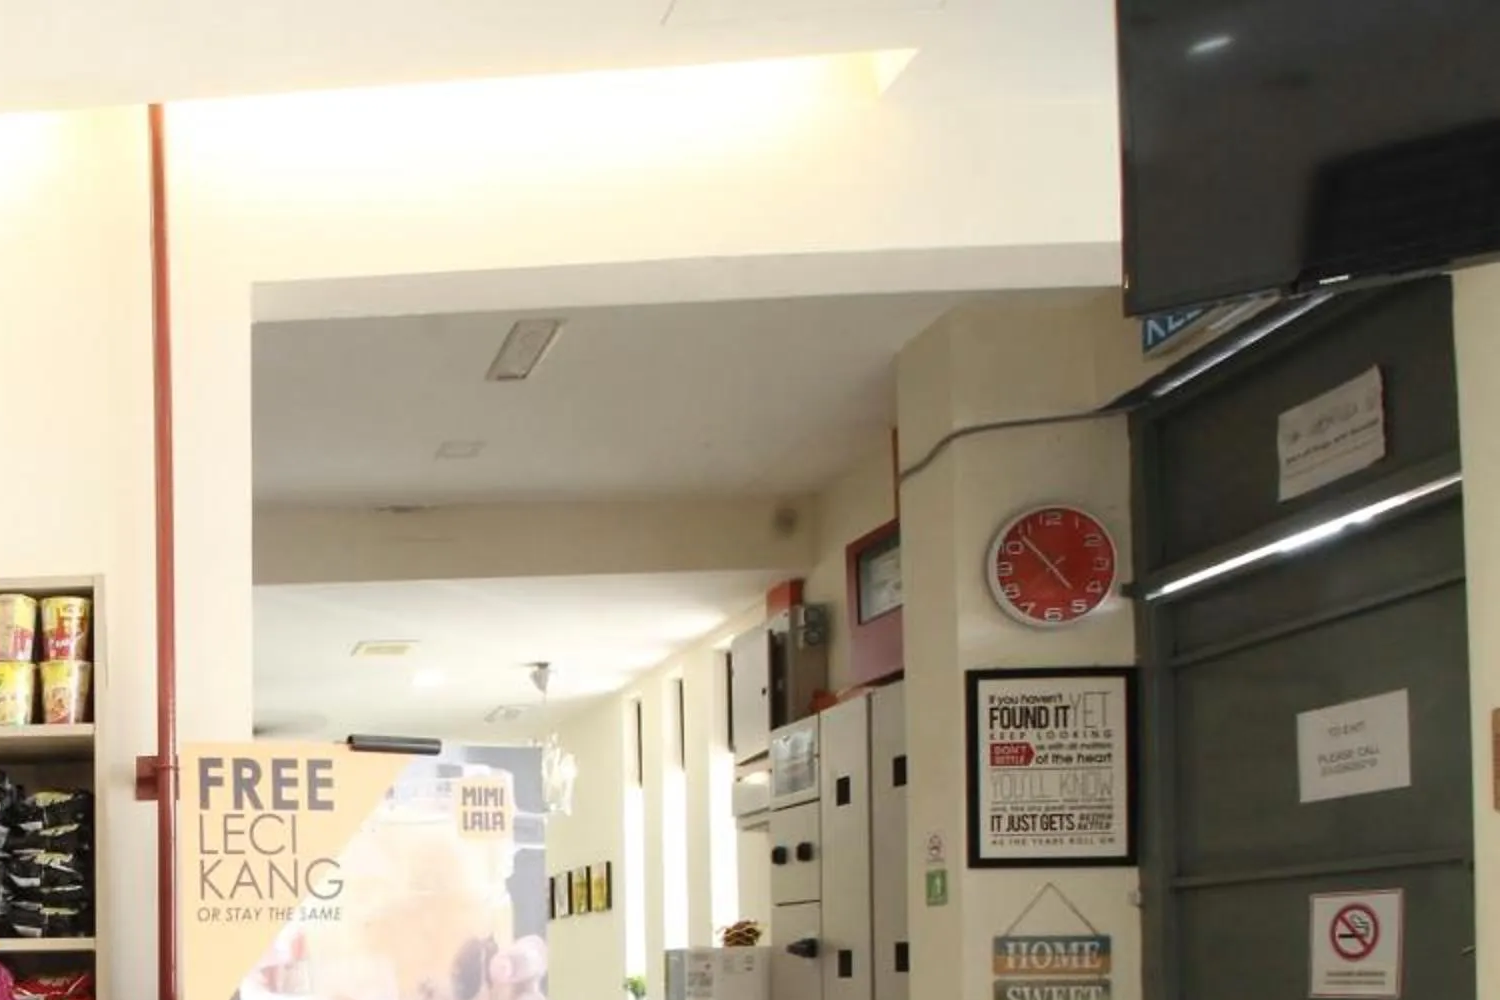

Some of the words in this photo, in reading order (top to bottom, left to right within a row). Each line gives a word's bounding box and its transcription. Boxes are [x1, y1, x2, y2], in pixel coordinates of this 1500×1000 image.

[989, 705, 1049, 730] FOUND
[1054, 704, 1071, 729] IT
[1068, 690, 1113, 728] YET
[1035, 729, 1112, 741] LOOKING
[1035, 753, 1049, 765] of
[1051, 753, 1073, 764] the
[1077, 751, 1112, 763] heart
[198, 757, 334, 811] FREE
[461, 785, 504, 807] MIMI
[462, 811, 505, 832] LALA
[991, 814, 1002, 832] IT
[1005, 813, 1037, 832] JUST
[1039, 812, 1077, 831] GETS
[199, 813, 297, 856] LECI
[199, 857, 344, 901] KANG
[197, 907, 221, 922] OR
[226, 907, 263, 922] STAY
[269, 907, 293, 921] THE
[299, 906, 342, 921] SAME
[1005, 941, 1101, 969] HOME
